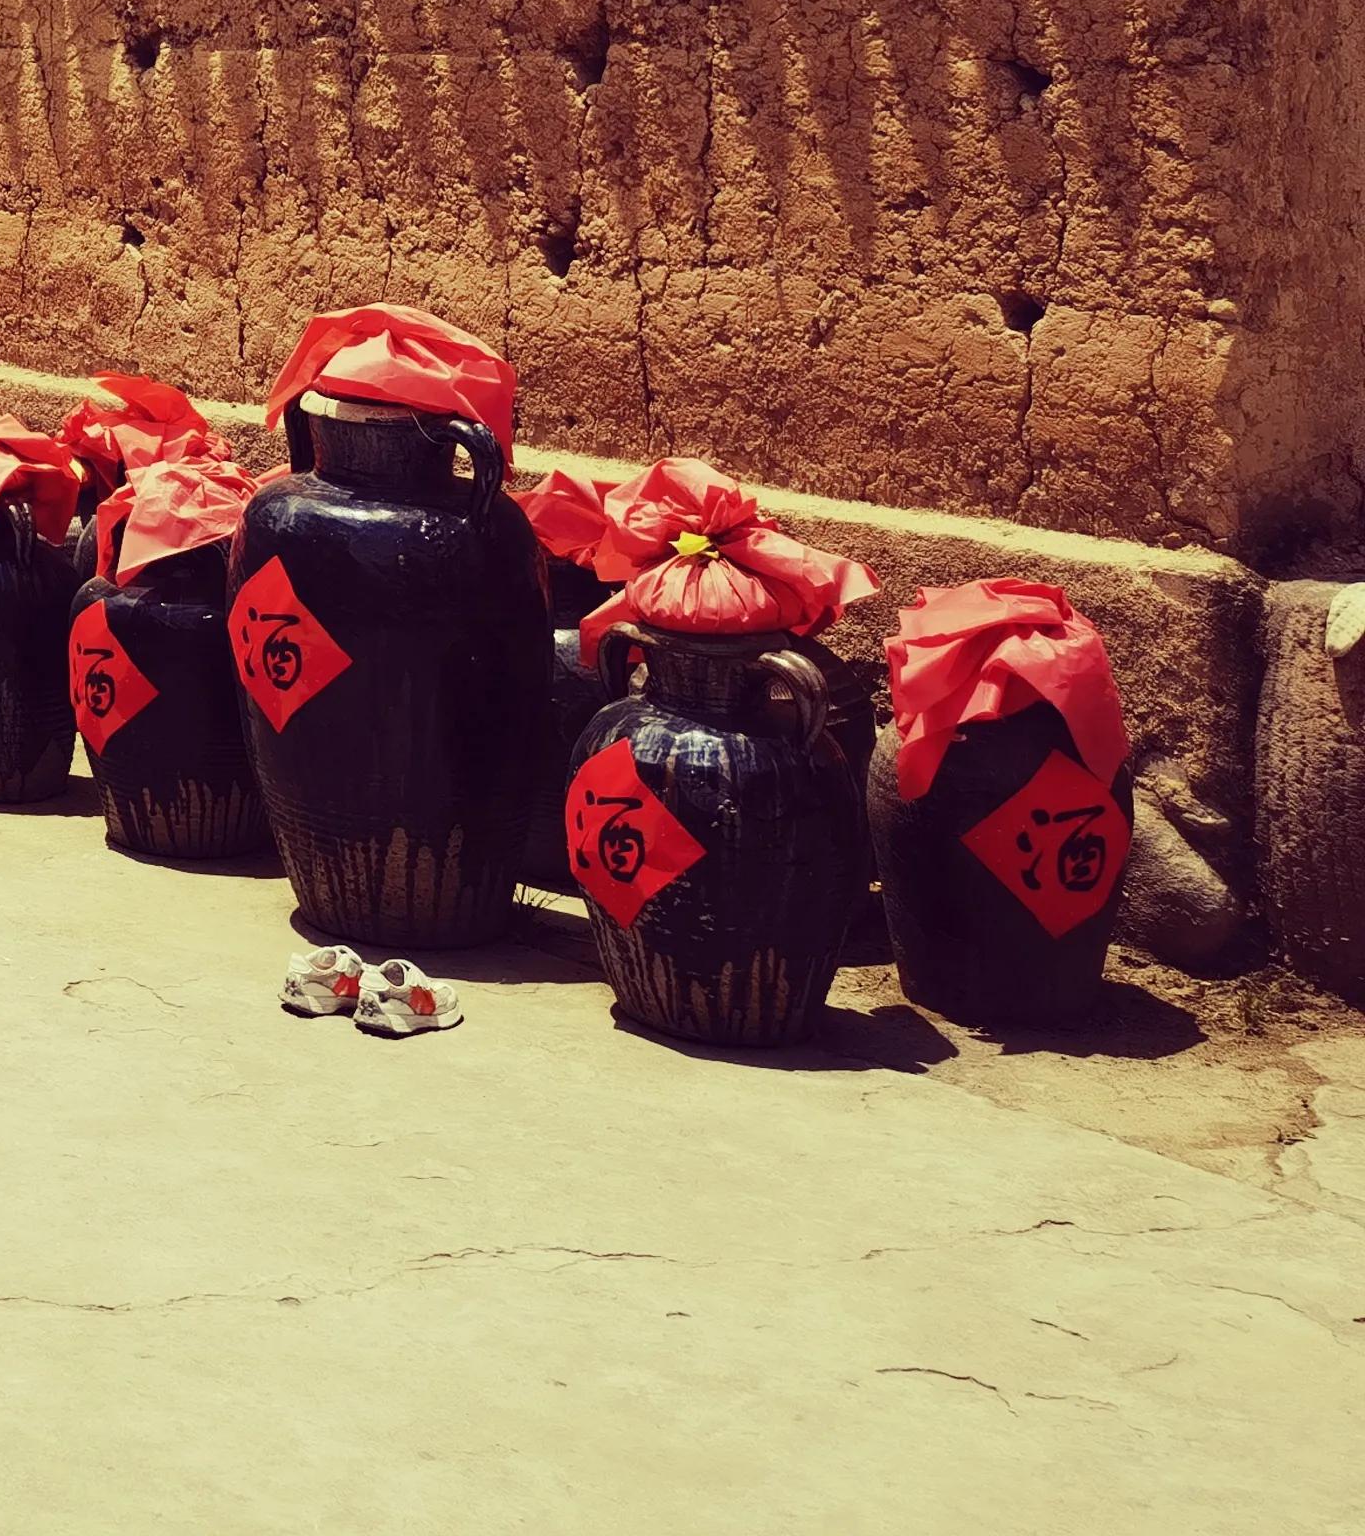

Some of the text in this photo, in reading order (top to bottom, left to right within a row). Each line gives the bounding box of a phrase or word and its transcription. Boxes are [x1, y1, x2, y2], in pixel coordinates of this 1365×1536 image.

[73, 642, 115, 718] 酒
[242, 607, 302, 691] 酒
[576, 790, 645, 883] 酒
[1016, 805, 1105, 891] 酒
